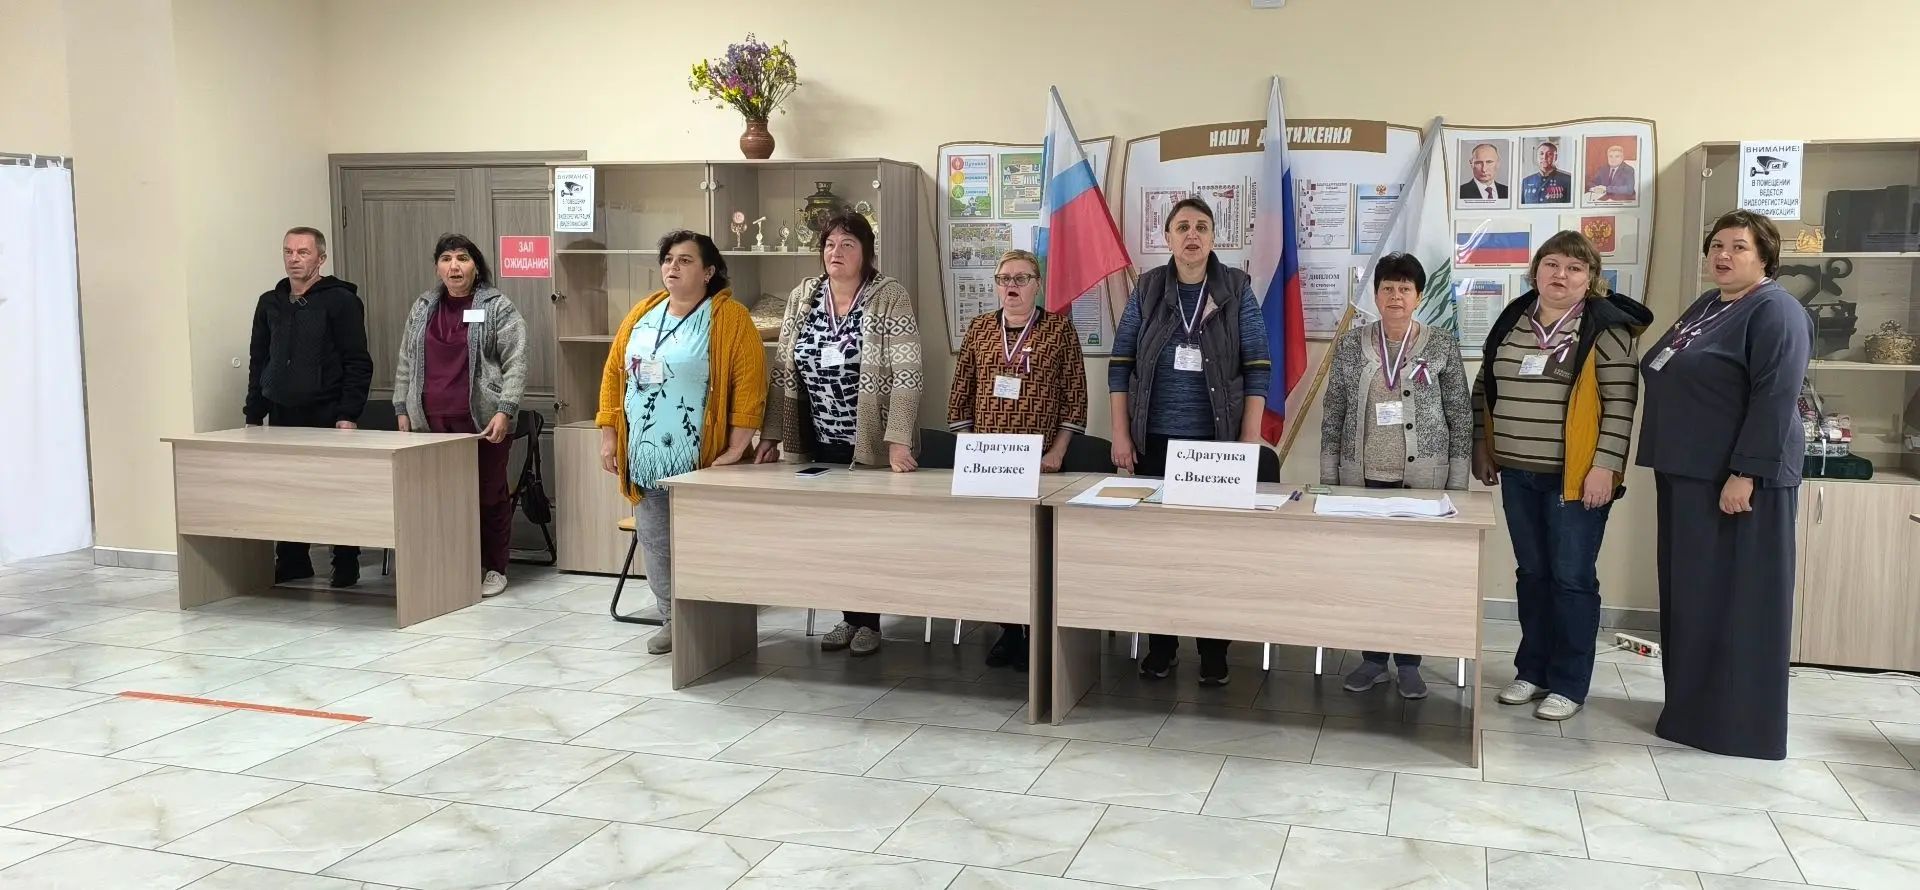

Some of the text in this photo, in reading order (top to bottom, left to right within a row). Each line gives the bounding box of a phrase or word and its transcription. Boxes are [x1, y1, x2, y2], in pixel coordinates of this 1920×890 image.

[1209, 127, 1352, 147] НАШИ ДТИЖЕНИЯ
[1746, 145, 1800, 153] ВНИМАНИЕ!
[1757, 179, 1790, 187] ПОМЕЩЕНИИ
[1760, 188, 1783, 197] ВЕДЕТСЯ
[518, 242, 534, 253] ЗАЛ
[504, 258, 549, 270] ОЖИДАНИЯ
[965, 441, 1030, 453] с.Драгунка
[1176, 449, 1246, 462] с.Драгунка
[963, 463, 1025, 474] с.Выезжее
[1174, 472, 1241, 484] с.Выезжее
